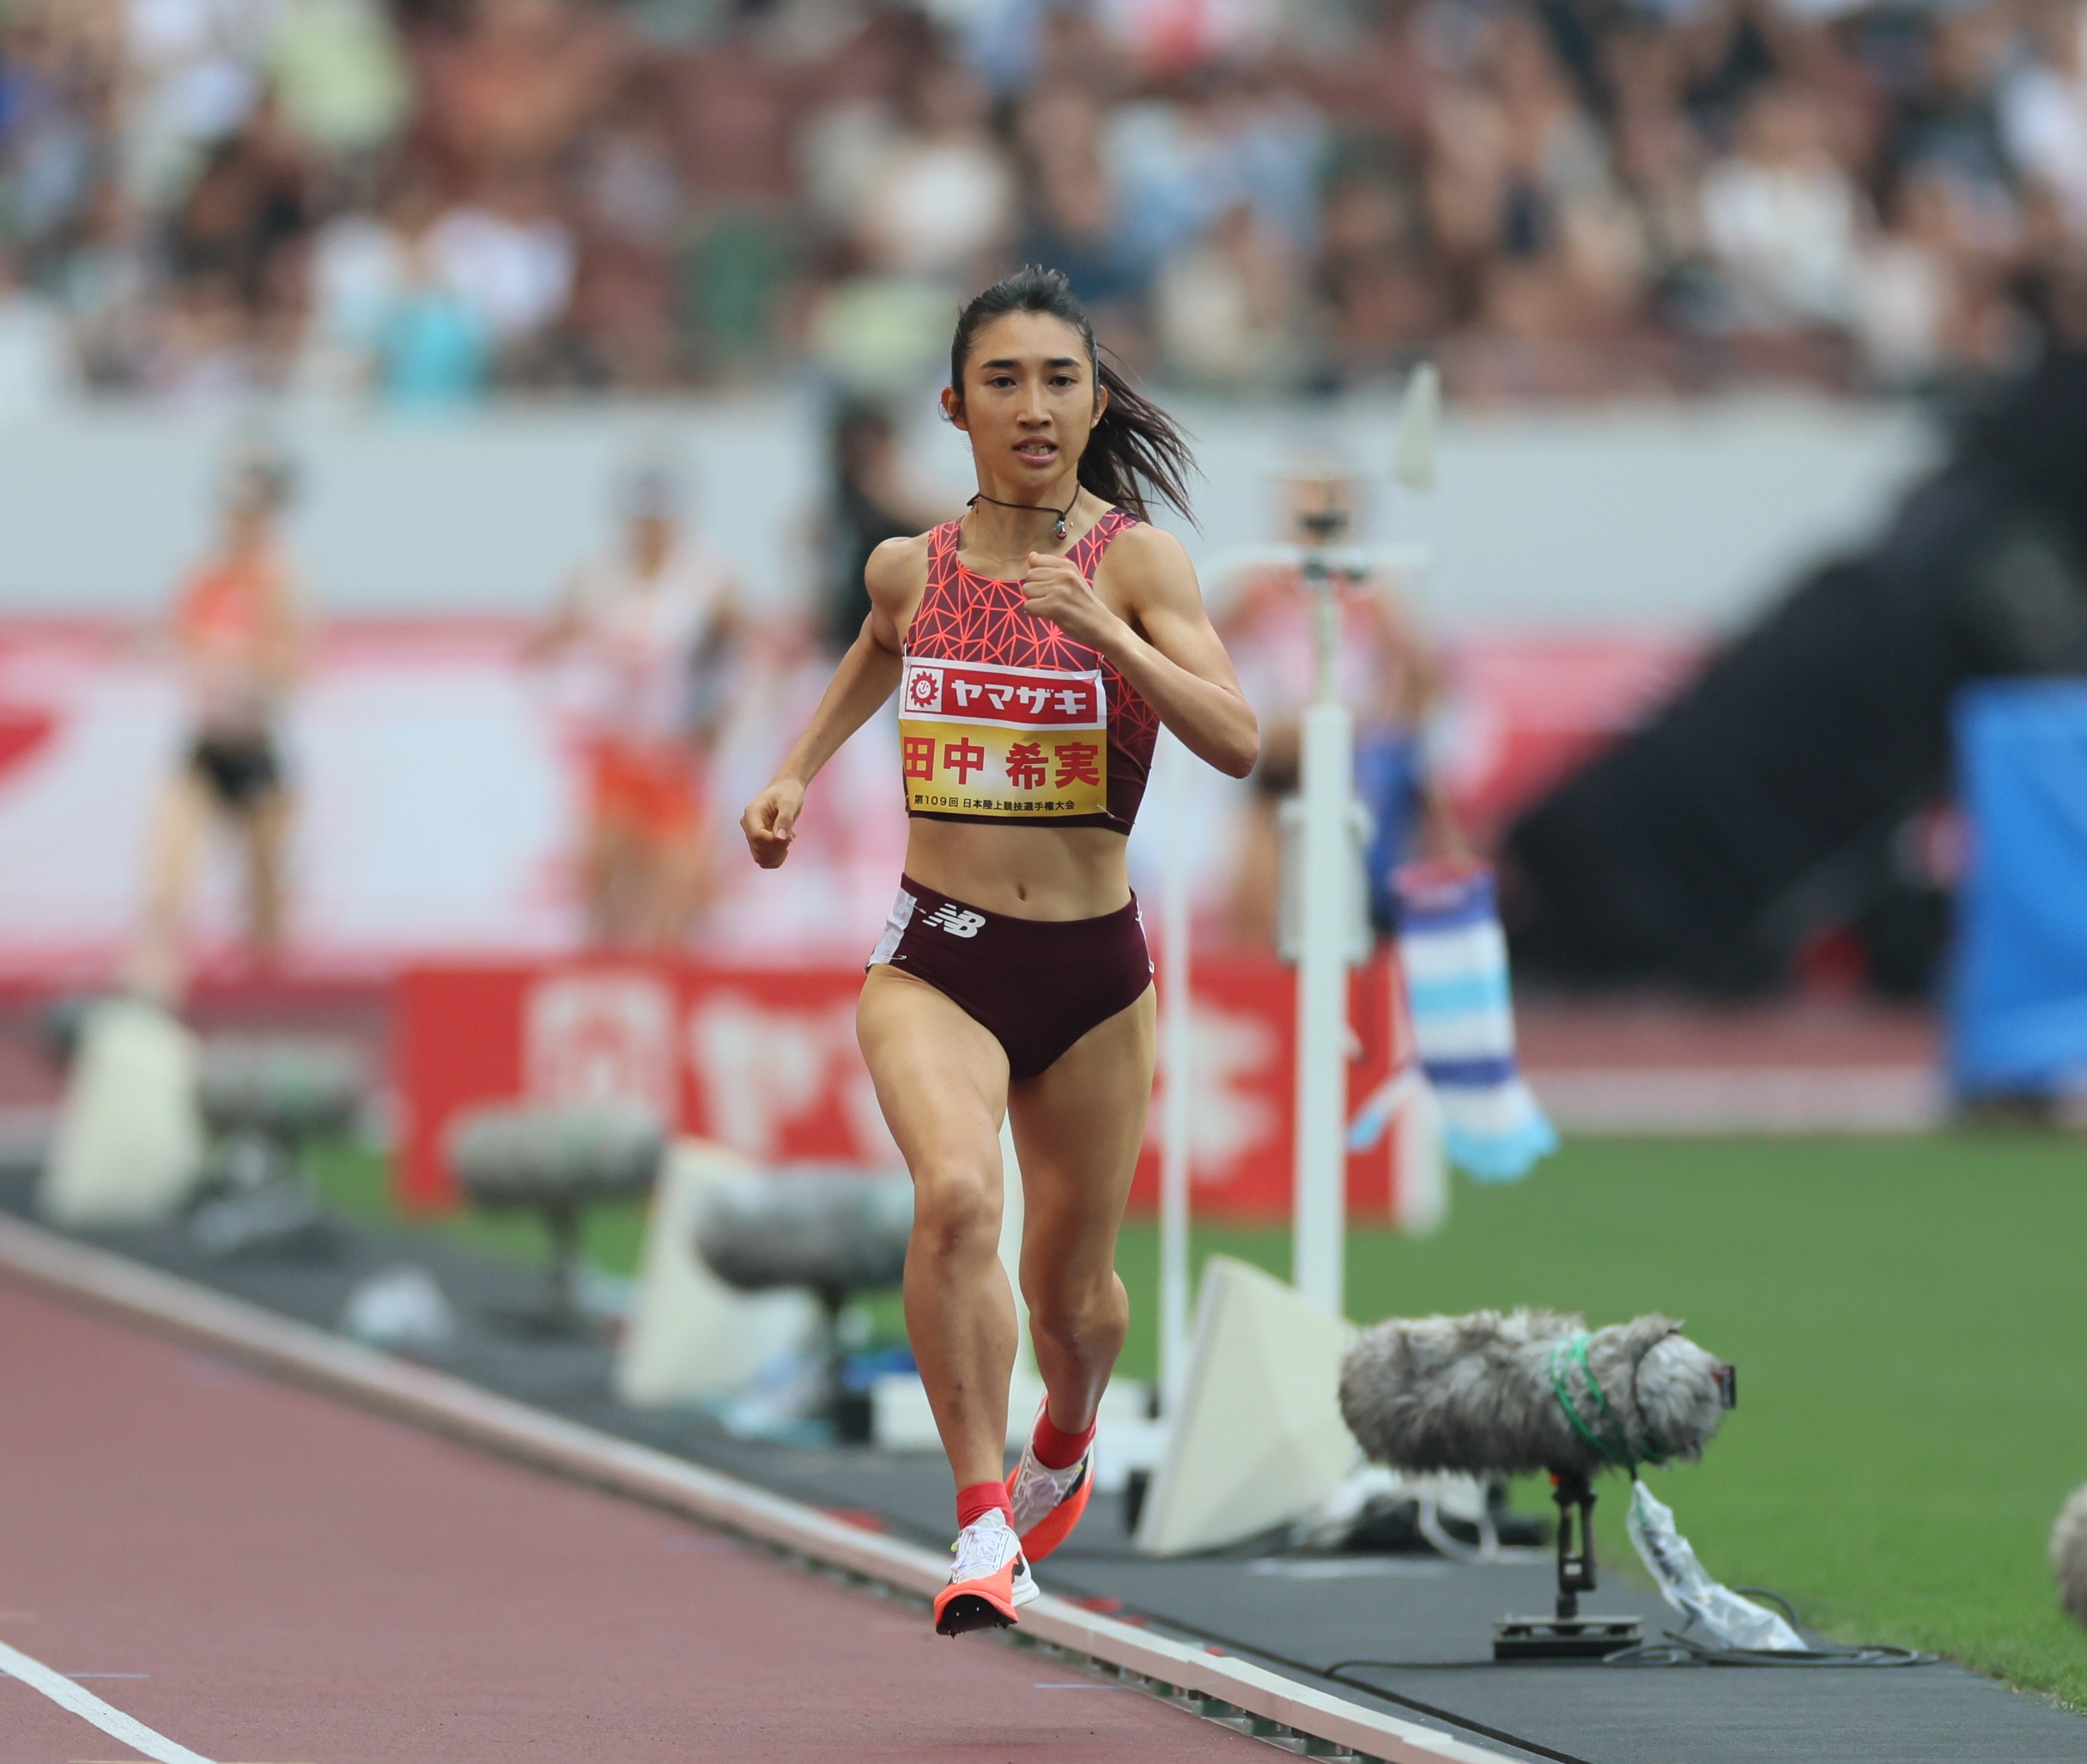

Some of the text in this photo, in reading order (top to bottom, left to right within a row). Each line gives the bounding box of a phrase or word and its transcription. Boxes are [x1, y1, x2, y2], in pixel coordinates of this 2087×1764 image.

[951, 679, 1086, 715] ヤマザキ
[903, 737, 1101, 790] 田中 希実
[914, 794, 1075, 811] 第109回 日本陸上競技選手権大会
